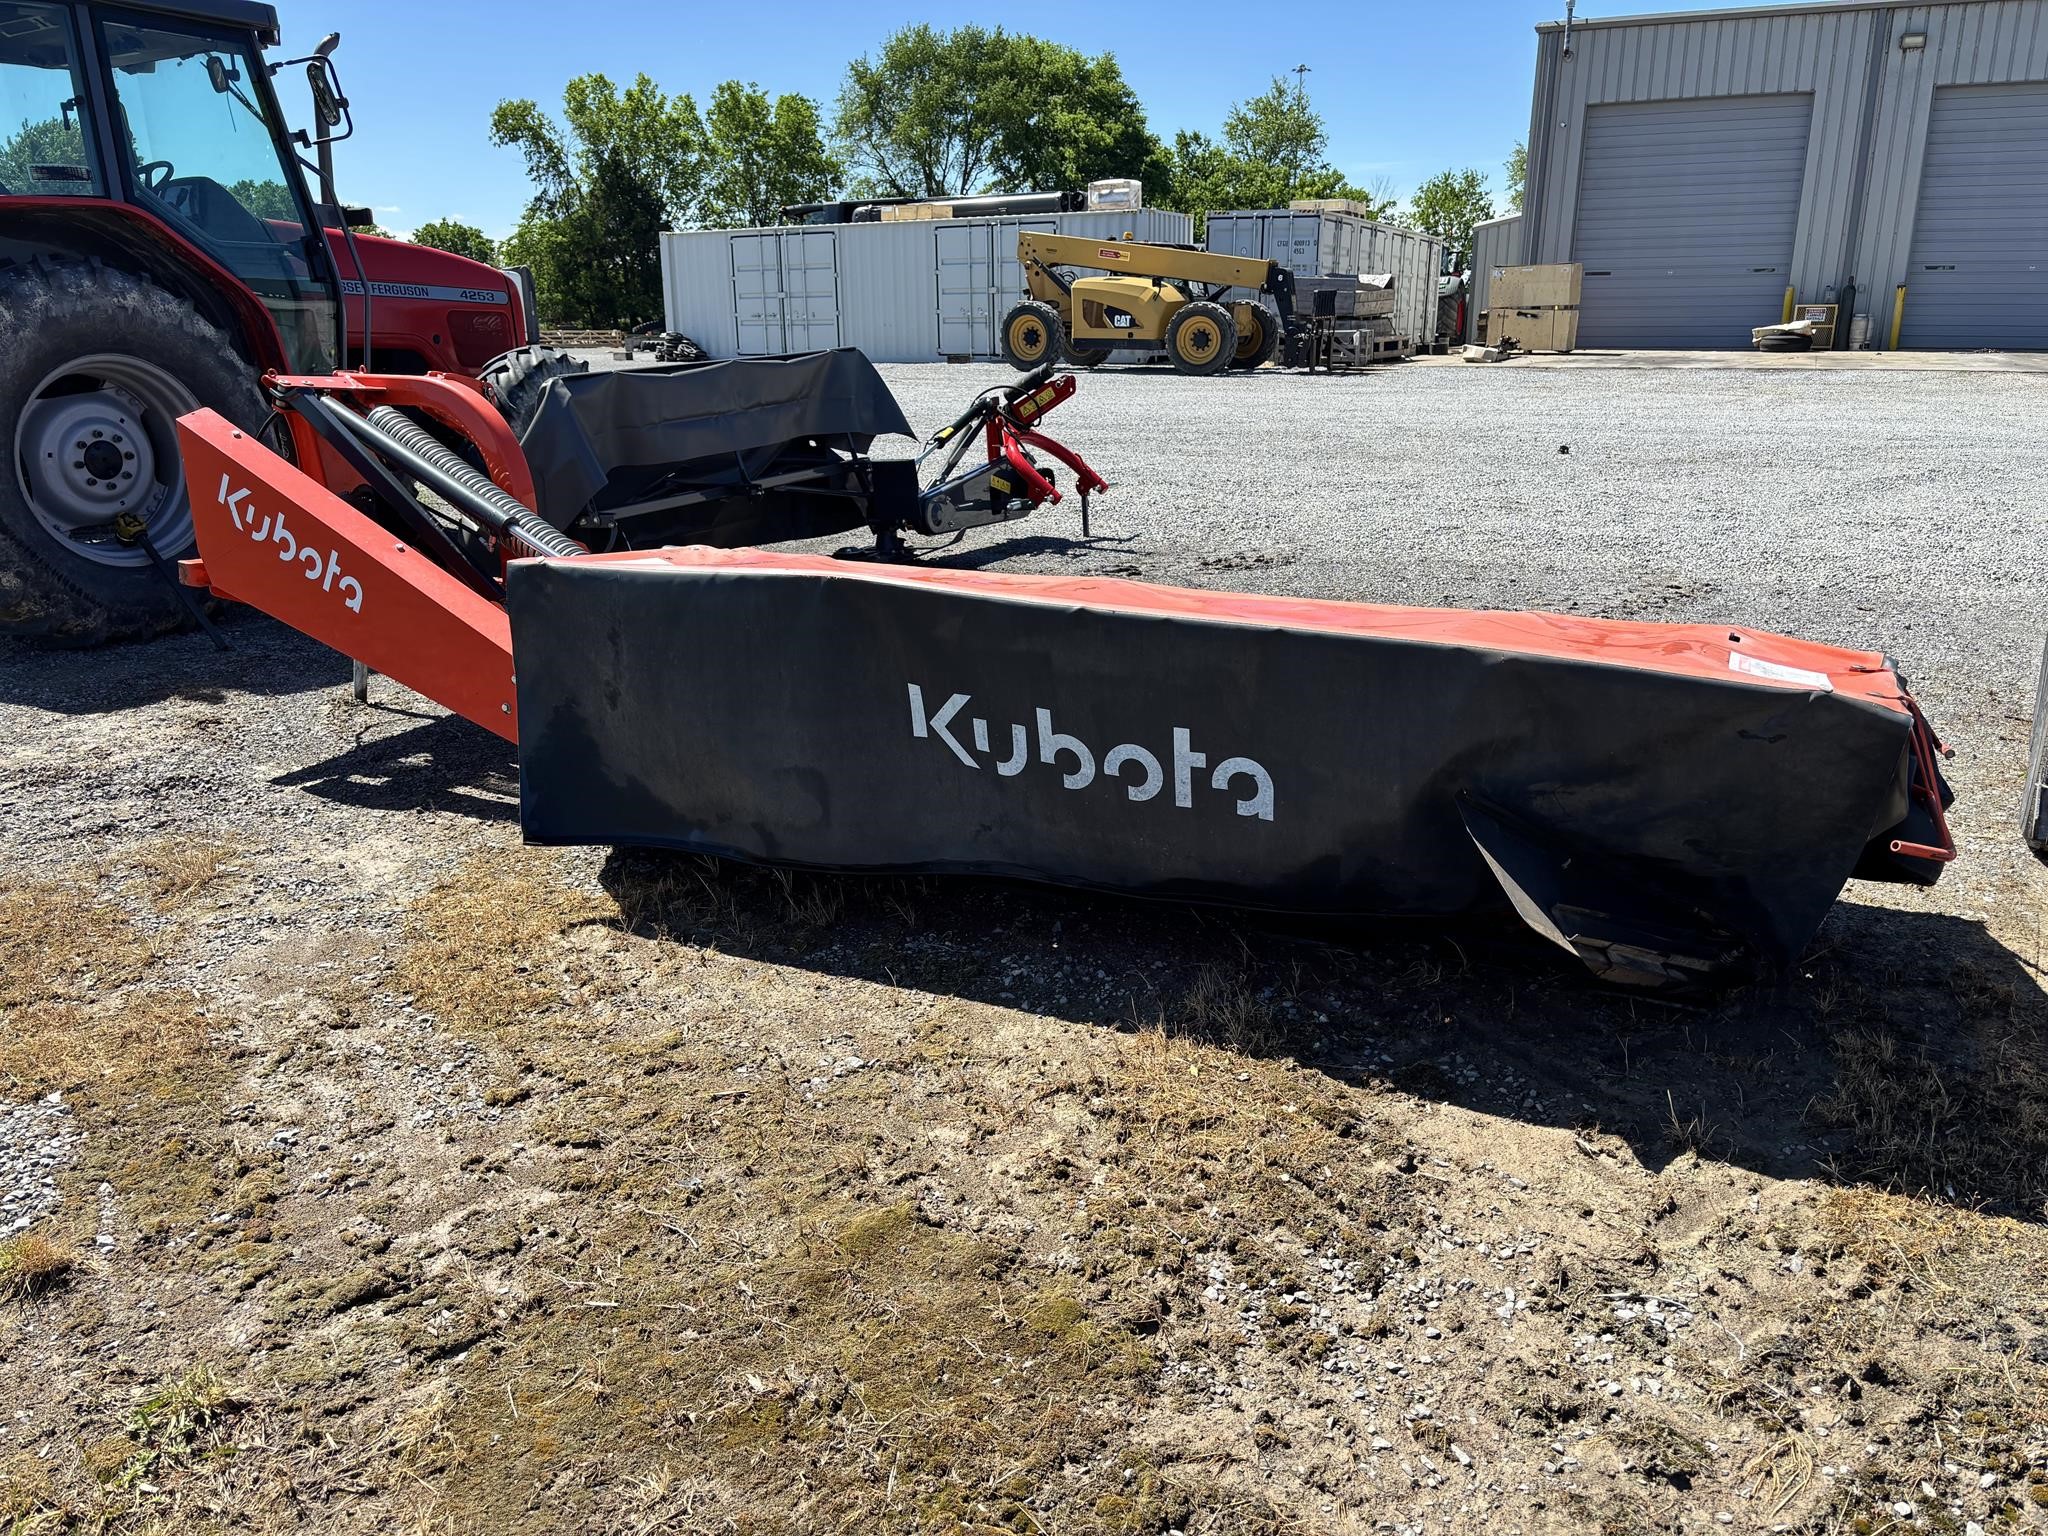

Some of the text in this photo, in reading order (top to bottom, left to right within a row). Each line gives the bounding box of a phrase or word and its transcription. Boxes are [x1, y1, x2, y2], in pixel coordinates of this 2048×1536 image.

[371, 283, 429, 297] FERGUSON
[459, 290, 495, 302] 4253
[1114, 315, 1132, 327] CAT
[217, 472, 363, 614] Kubota
[907, 682, 1274, 822] Kubota
